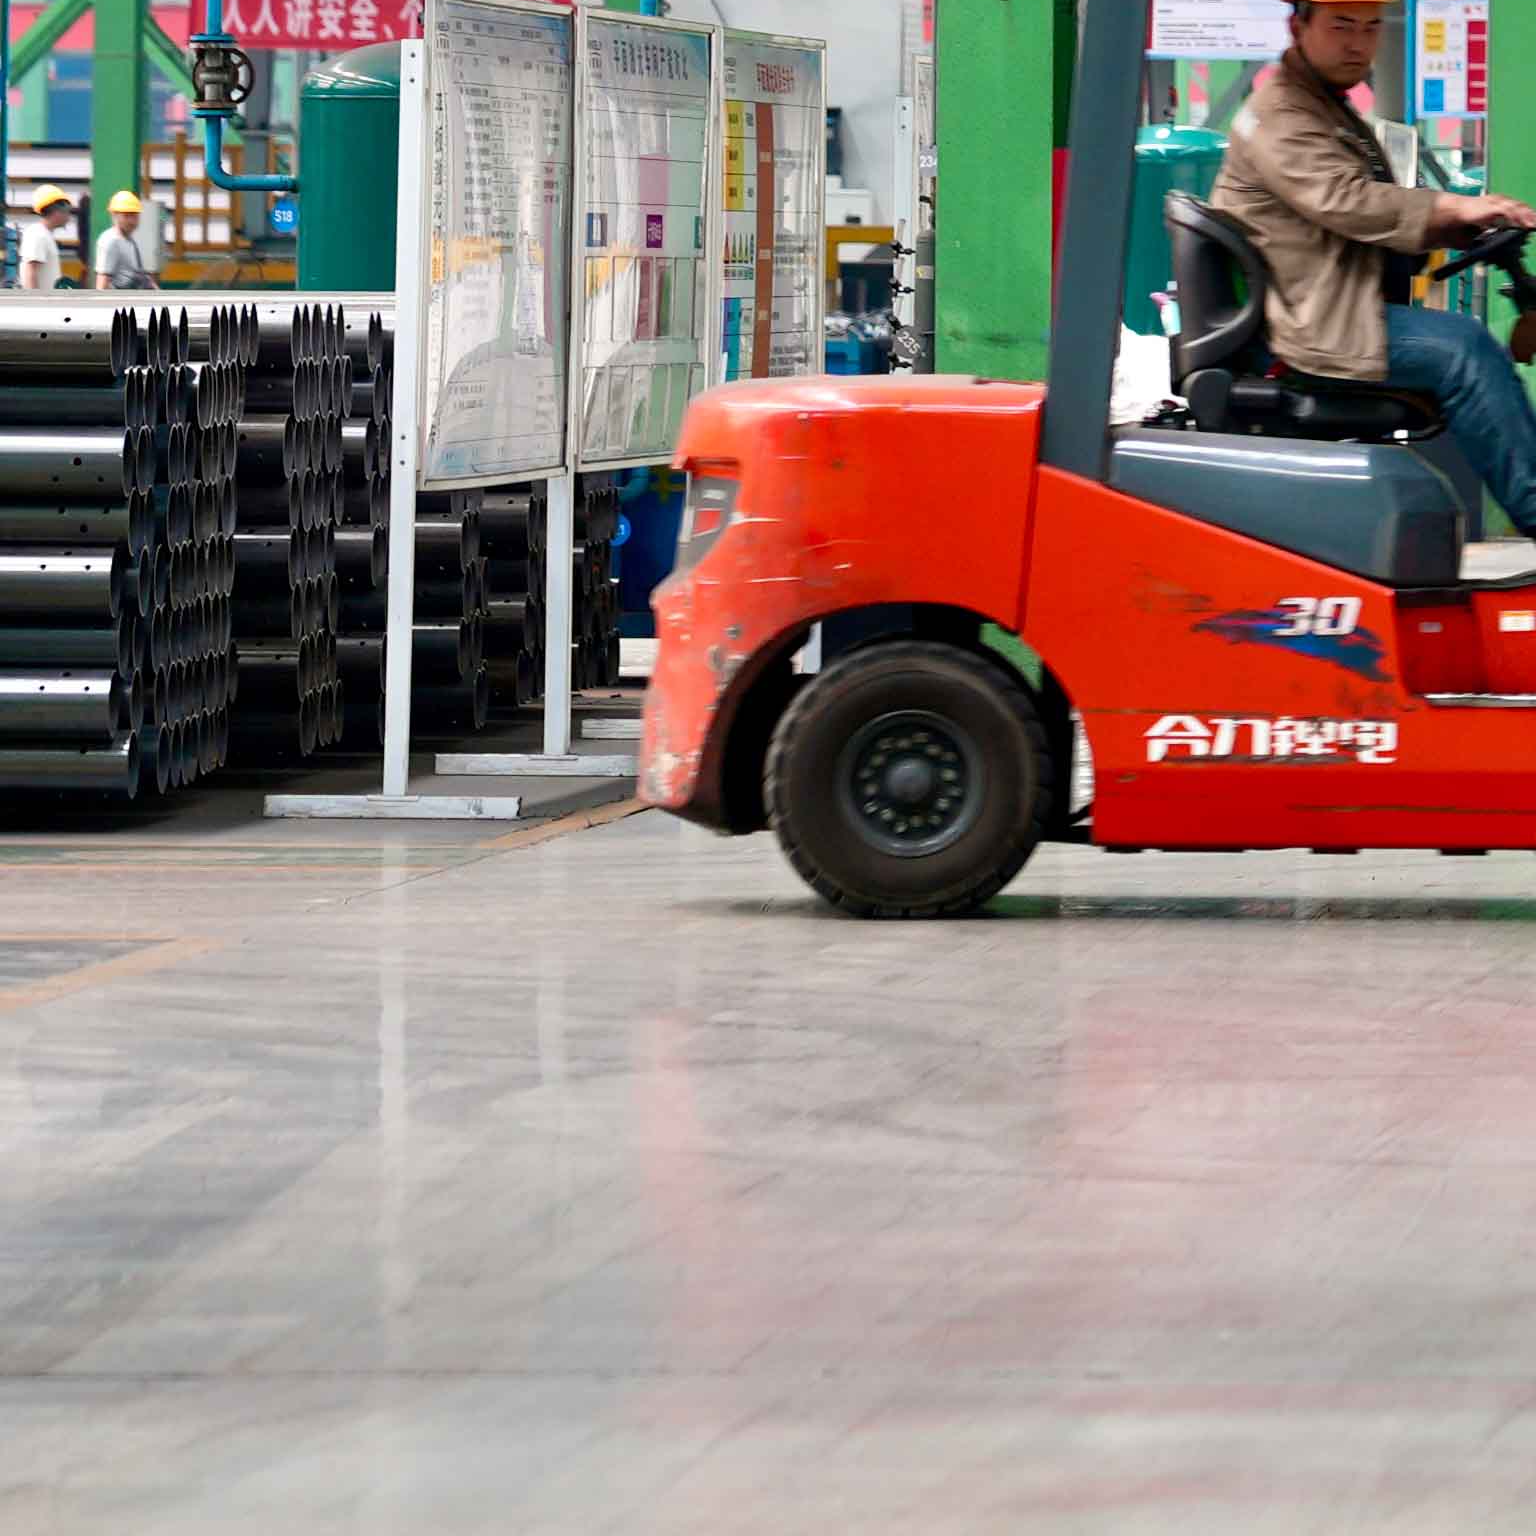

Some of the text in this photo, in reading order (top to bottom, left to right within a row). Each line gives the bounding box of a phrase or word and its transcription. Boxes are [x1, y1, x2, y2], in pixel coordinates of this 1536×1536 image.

[896, 332, 922, 355] 235
[1272, 597, 1362, 636] 30
[1143, 715, 1398, 763] 合力锂电
